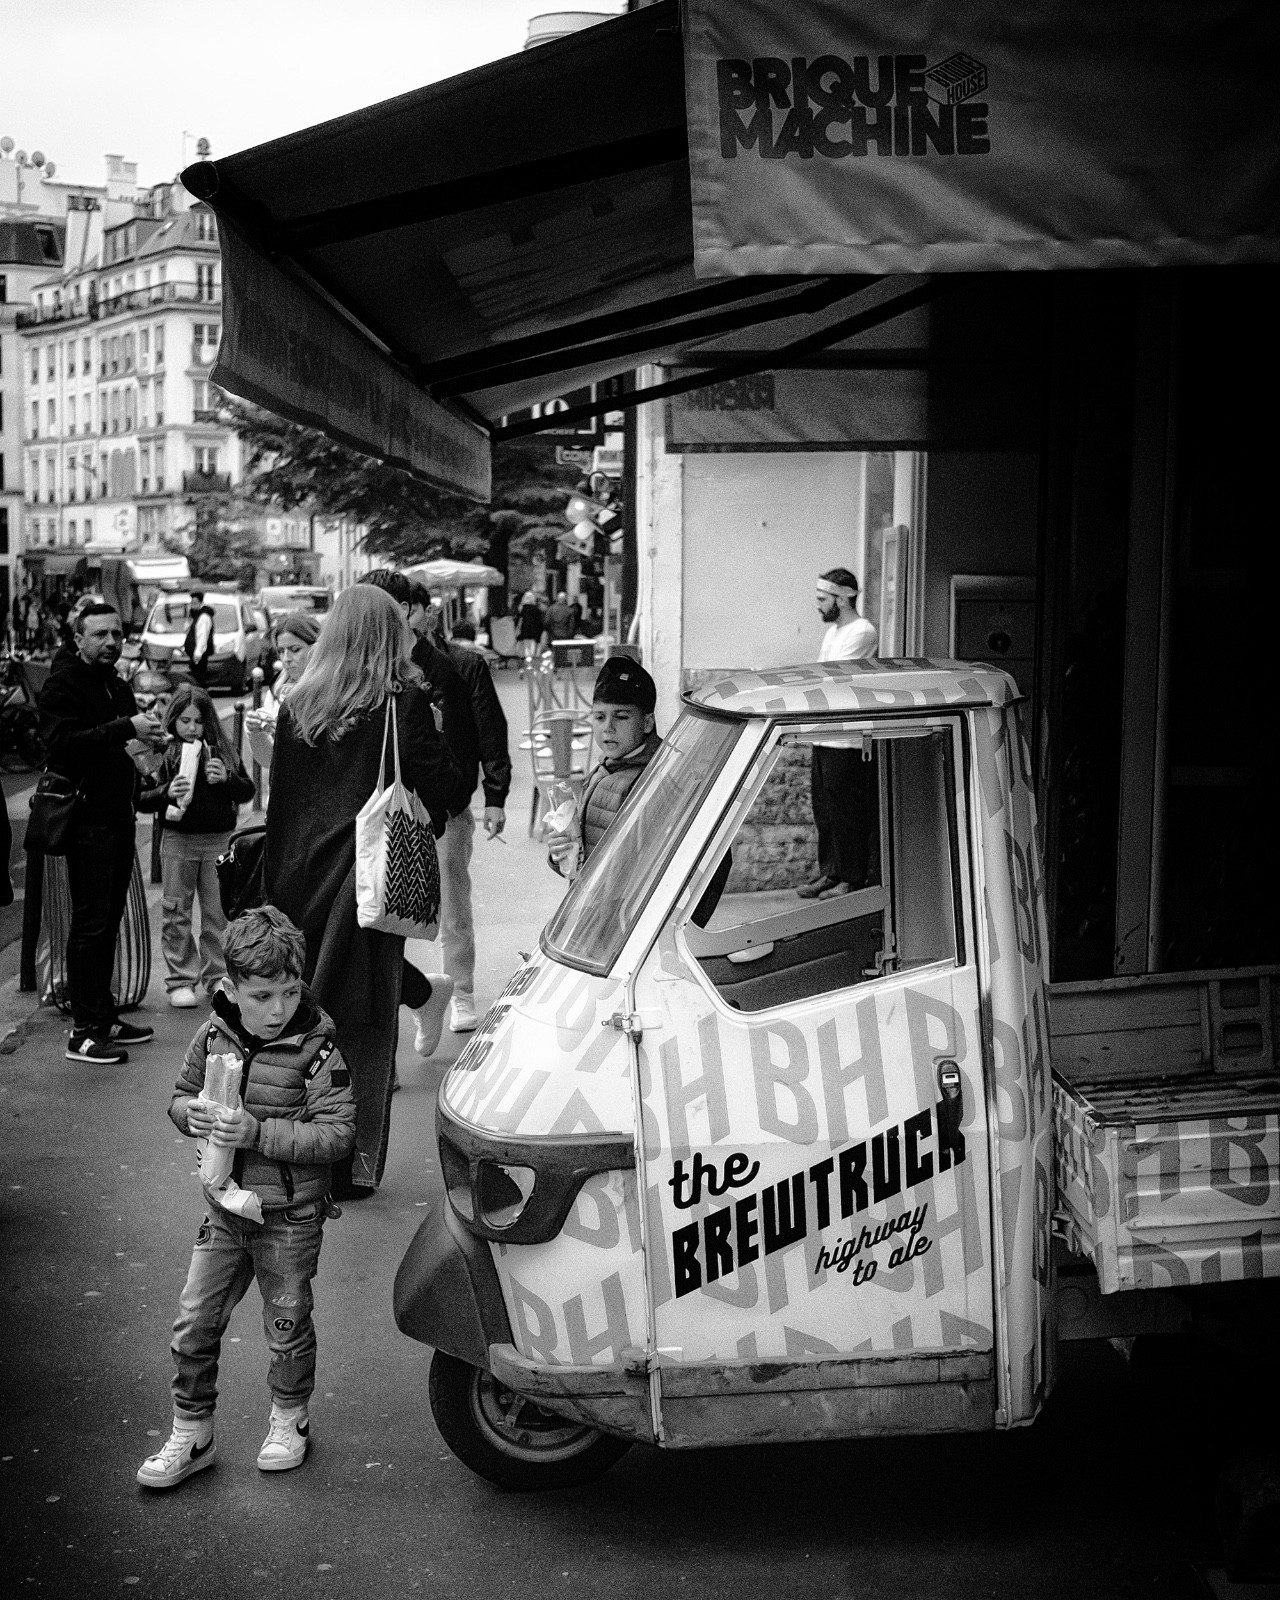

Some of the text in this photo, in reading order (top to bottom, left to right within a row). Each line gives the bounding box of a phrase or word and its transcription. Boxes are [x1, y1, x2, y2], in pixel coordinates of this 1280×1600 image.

[717, 54, 927, 110] BRIQUE
[926, 55, 983, 88] BRIQUE
[947, 70, 985, 104] HOUSE
[719, 103, 991, 158] MACHINE
[669, 1152, 761, 1209] the
[672, 1098, 966, 1299] BREWTRUCK
[815, 1202, 929, 1275] highway
[853, 1225, 933, 1287] to ale
